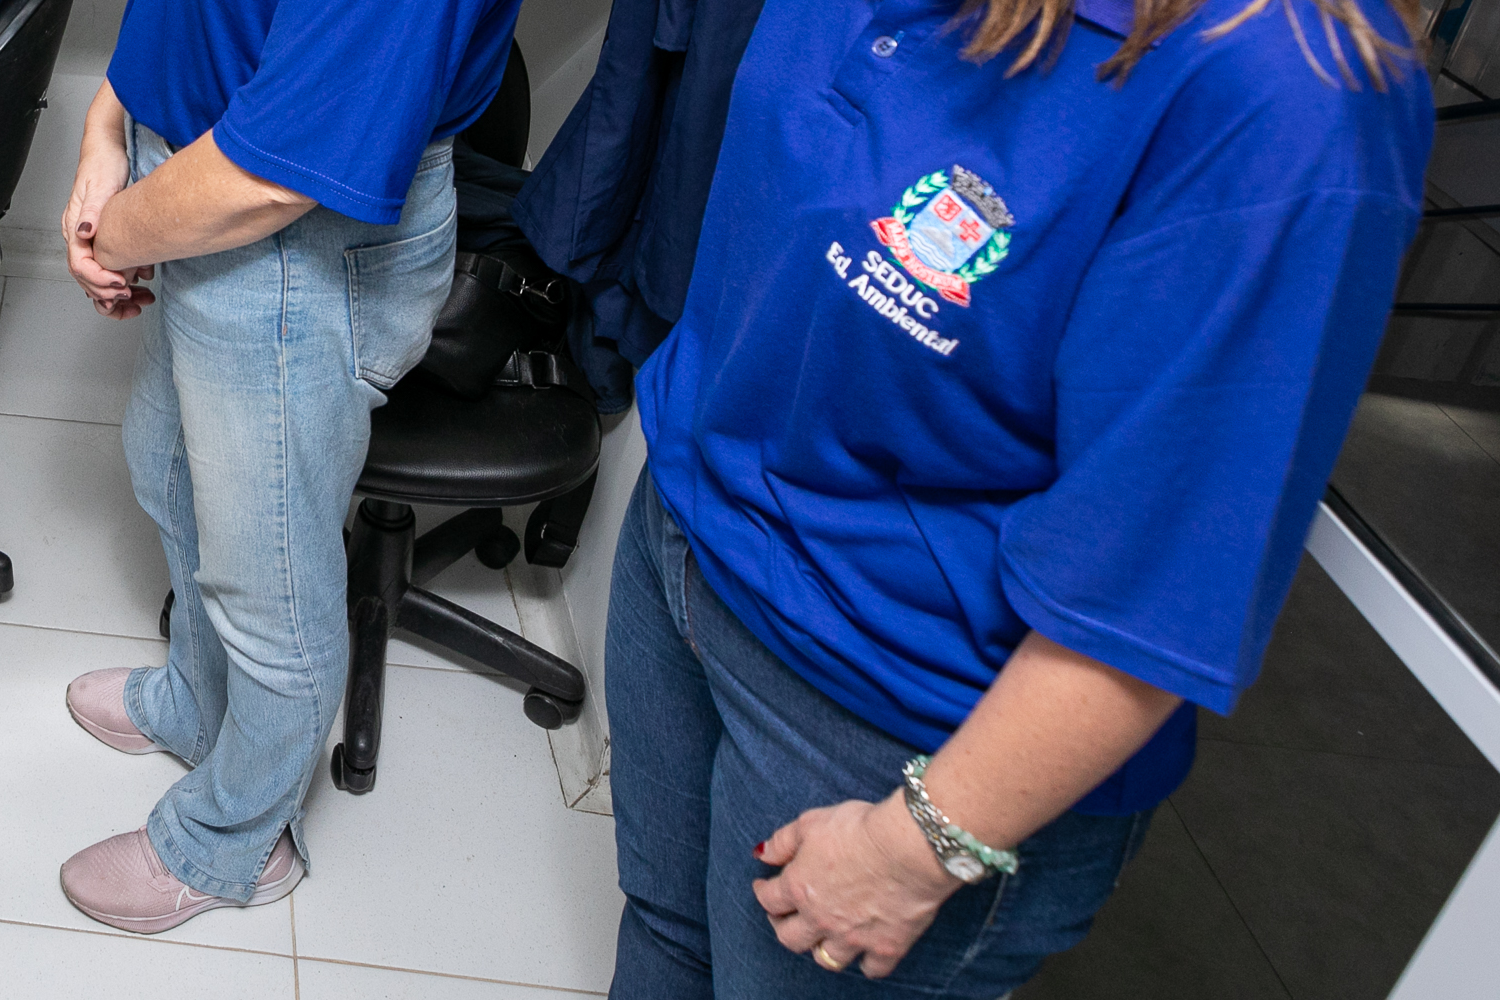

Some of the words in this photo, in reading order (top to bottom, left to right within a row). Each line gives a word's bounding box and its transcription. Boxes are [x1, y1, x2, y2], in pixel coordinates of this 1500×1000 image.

[825, 241, 852, 279] Ed.
[848, 273, 960, 356] Ambiental
[862, 250, 939, 319] SEDUC
